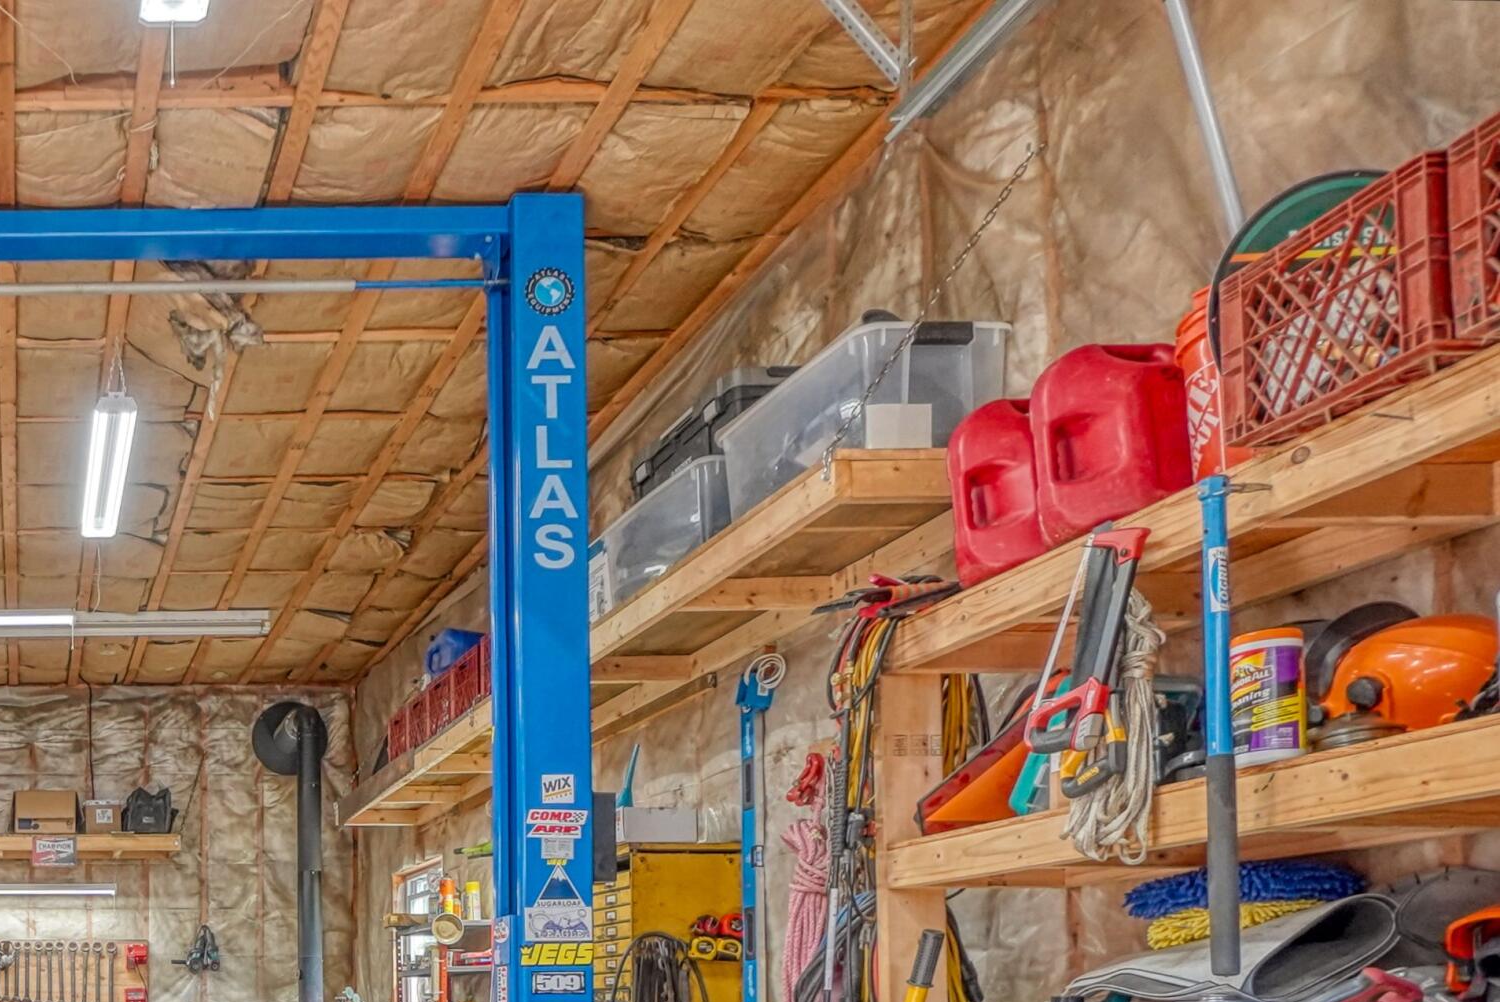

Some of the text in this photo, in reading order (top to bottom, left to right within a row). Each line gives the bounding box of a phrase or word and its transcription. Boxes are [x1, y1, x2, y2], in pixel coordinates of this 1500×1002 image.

[527, 293, 572, 314] EQUIPMENT
[526, 325, 579, 569] ATLAS
[1231, 688, 1272, 709] aning
[543, 776, 571, 793] WIX
[530, 811, 573, 821] COMP
[532, 825, 580, 833] ARP
[38, 840, 72, 850] CHAMPION
[520, 943, 594, 966] JEGS
[534, 974, 582, 991] 509
